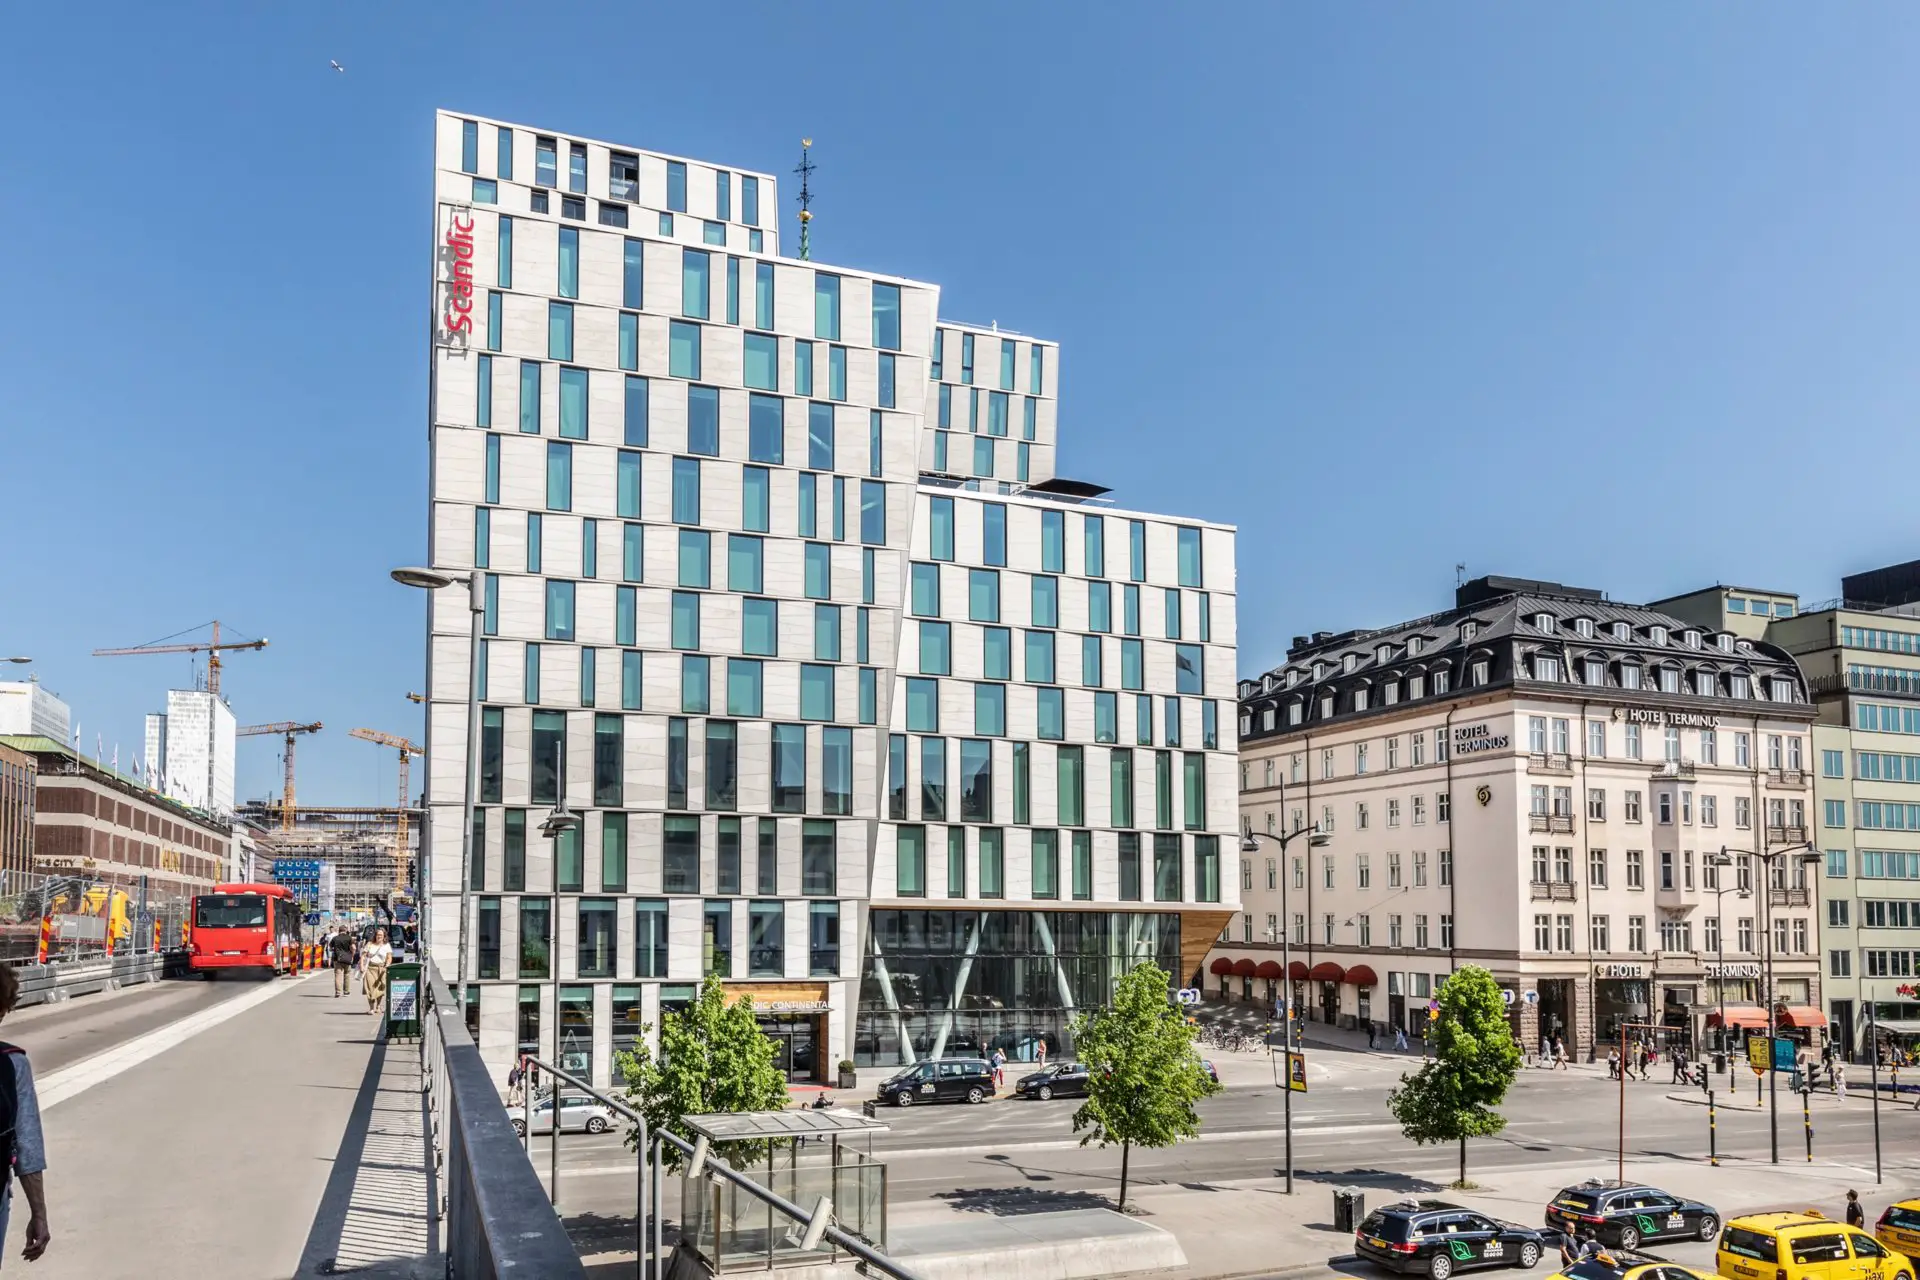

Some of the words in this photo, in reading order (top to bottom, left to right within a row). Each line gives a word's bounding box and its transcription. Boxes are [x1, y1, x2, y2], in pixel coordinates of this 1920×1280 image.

[446, 215, 475, 335] Scandic
[1630, 708, 1665, 723] HOTEL
[1668, 712, 1721, 728] TERMINUS
[1454, 724, 1488, 740] HOTEL
[1453, 735, 1508, 754] TERMINUS
[53, 858, 76, 867] CITY
[1611, 964, 1646, 977] HOTEL
[1709, 964, 1761, 977] TERMINUS
[1526, 992, 1536, 1003] T
[771, 1001, 833, 1010] CONTINENTA
